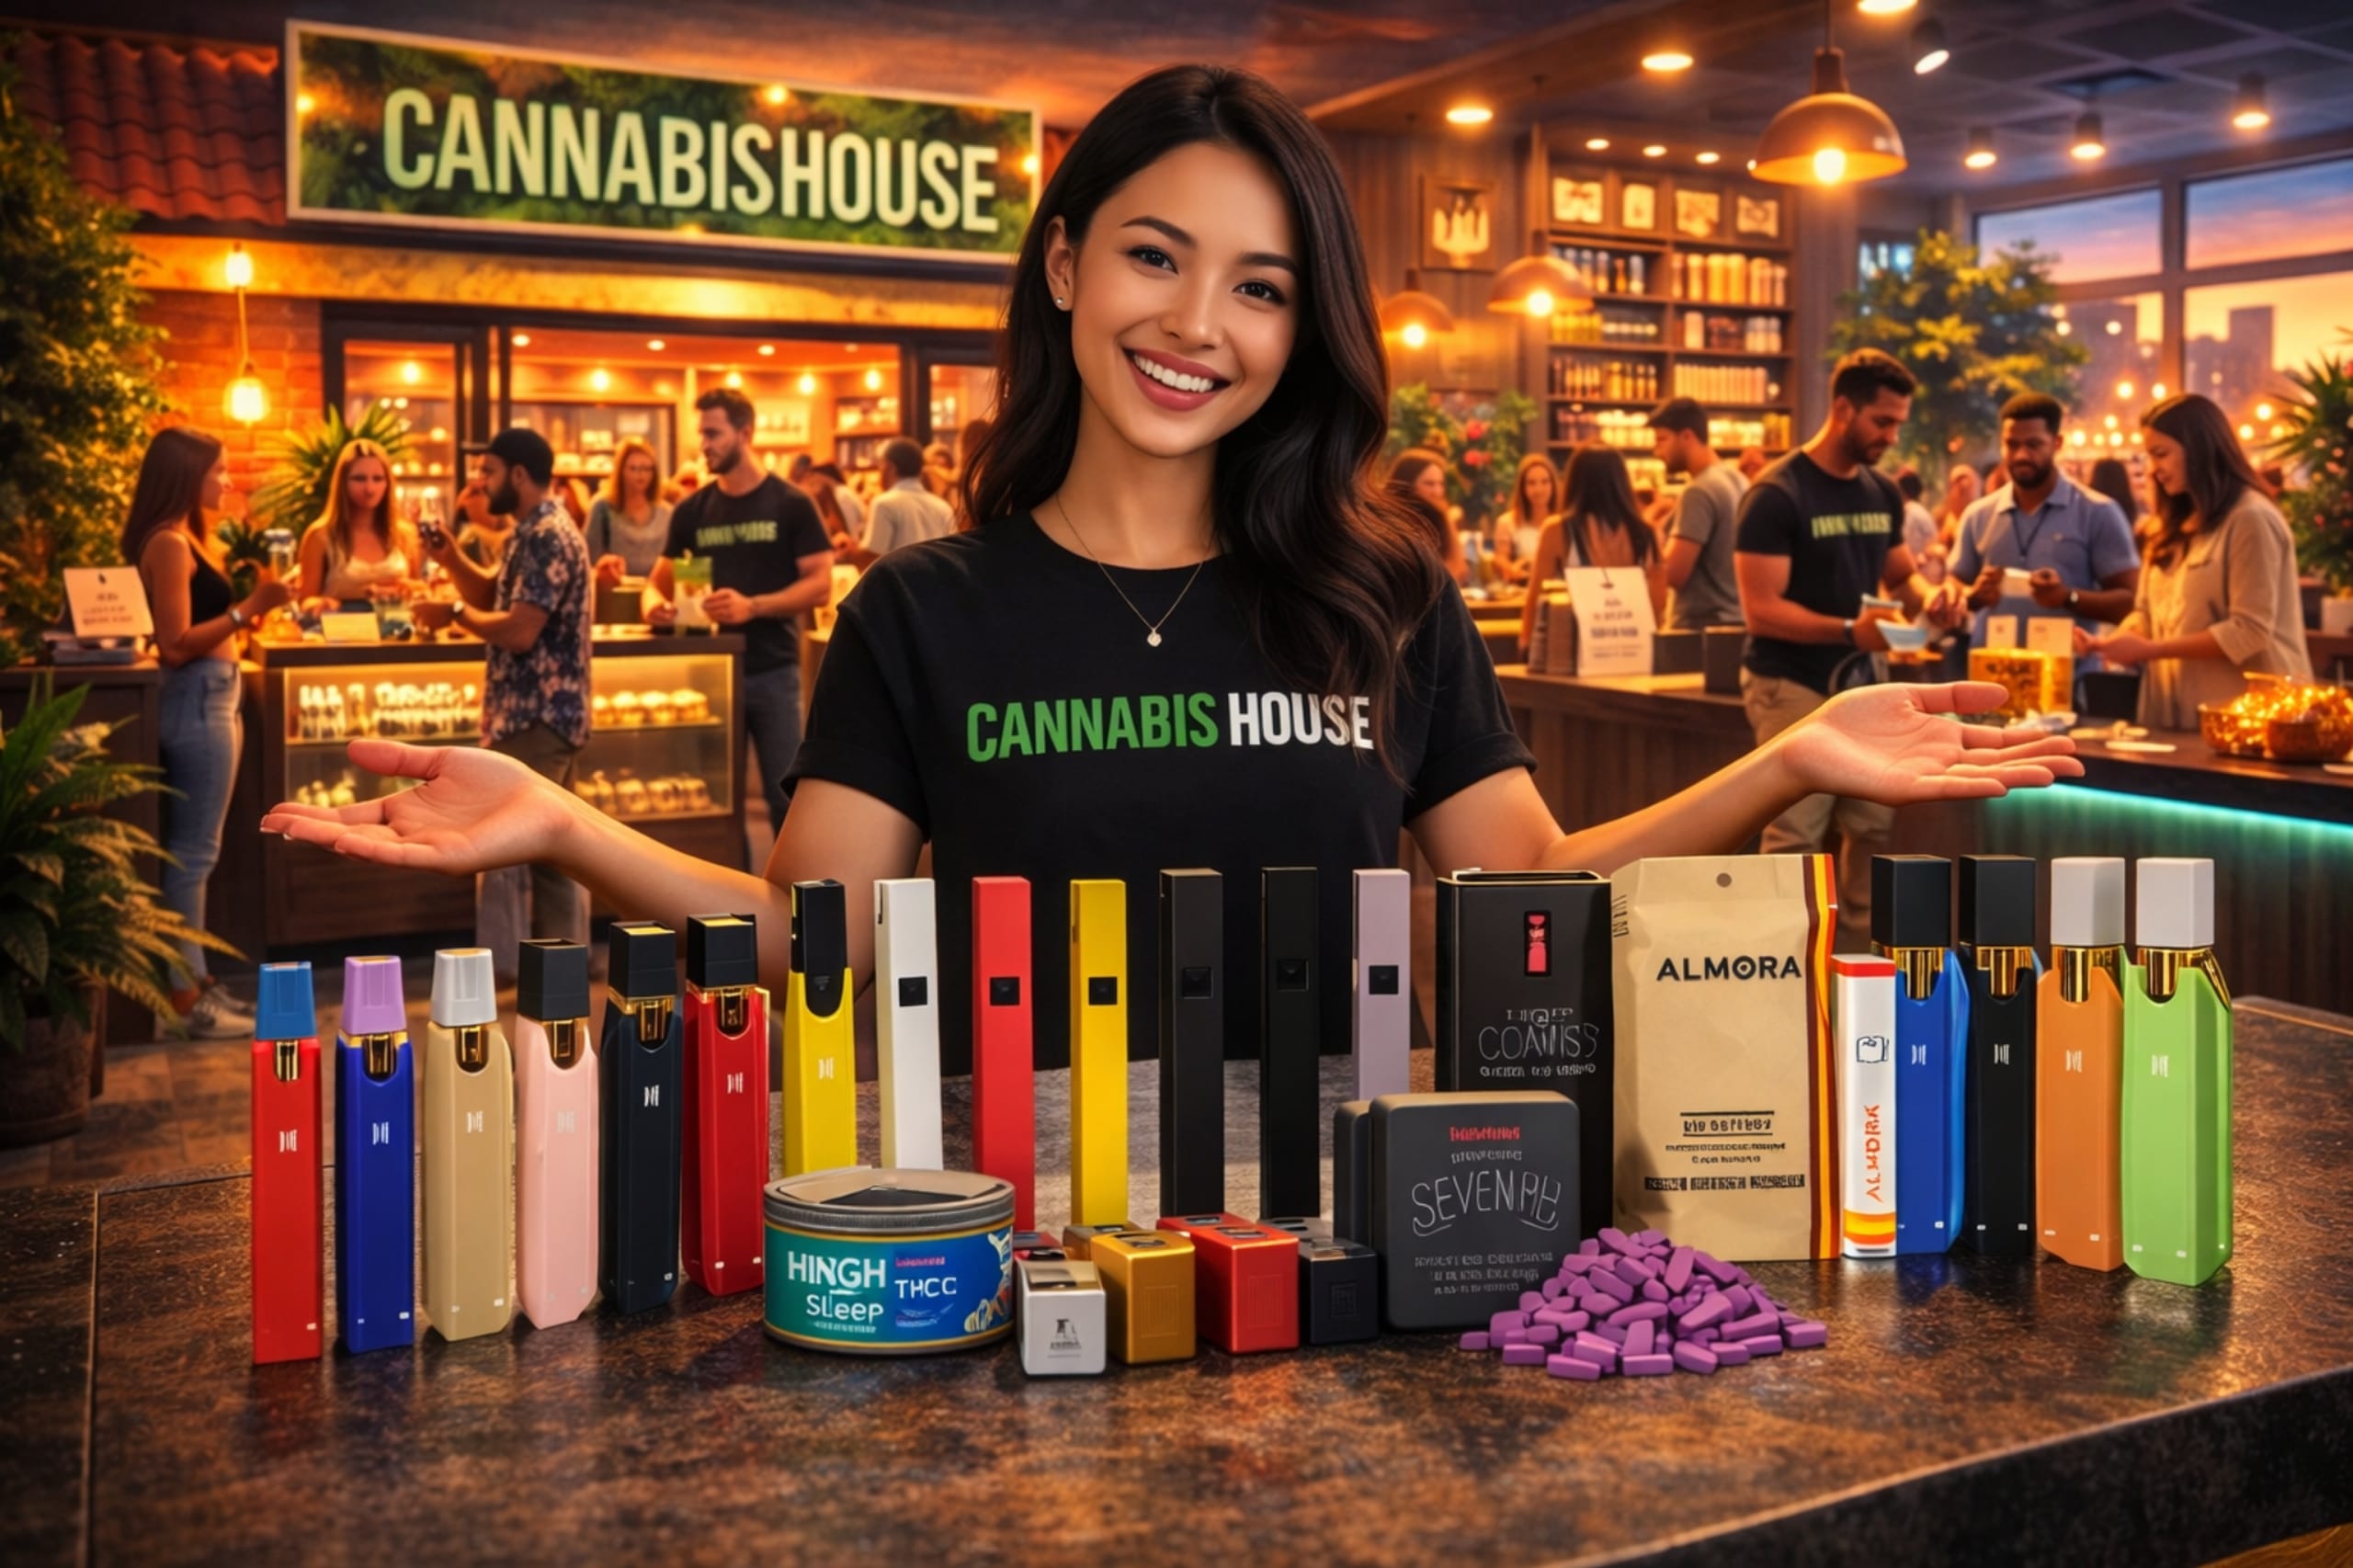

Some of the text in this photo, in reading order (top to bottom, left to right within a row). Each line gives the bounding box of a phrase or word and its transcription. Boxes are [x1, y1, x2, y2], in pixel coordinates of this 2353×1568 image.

[967, 691, 1374, 762] CANNABIS HOUSE
[1655, 955, 1802, 982] ALMORA
[788, 1251, 886, 1289] HINGH
[894, 1276, 957, 1299] THCC
